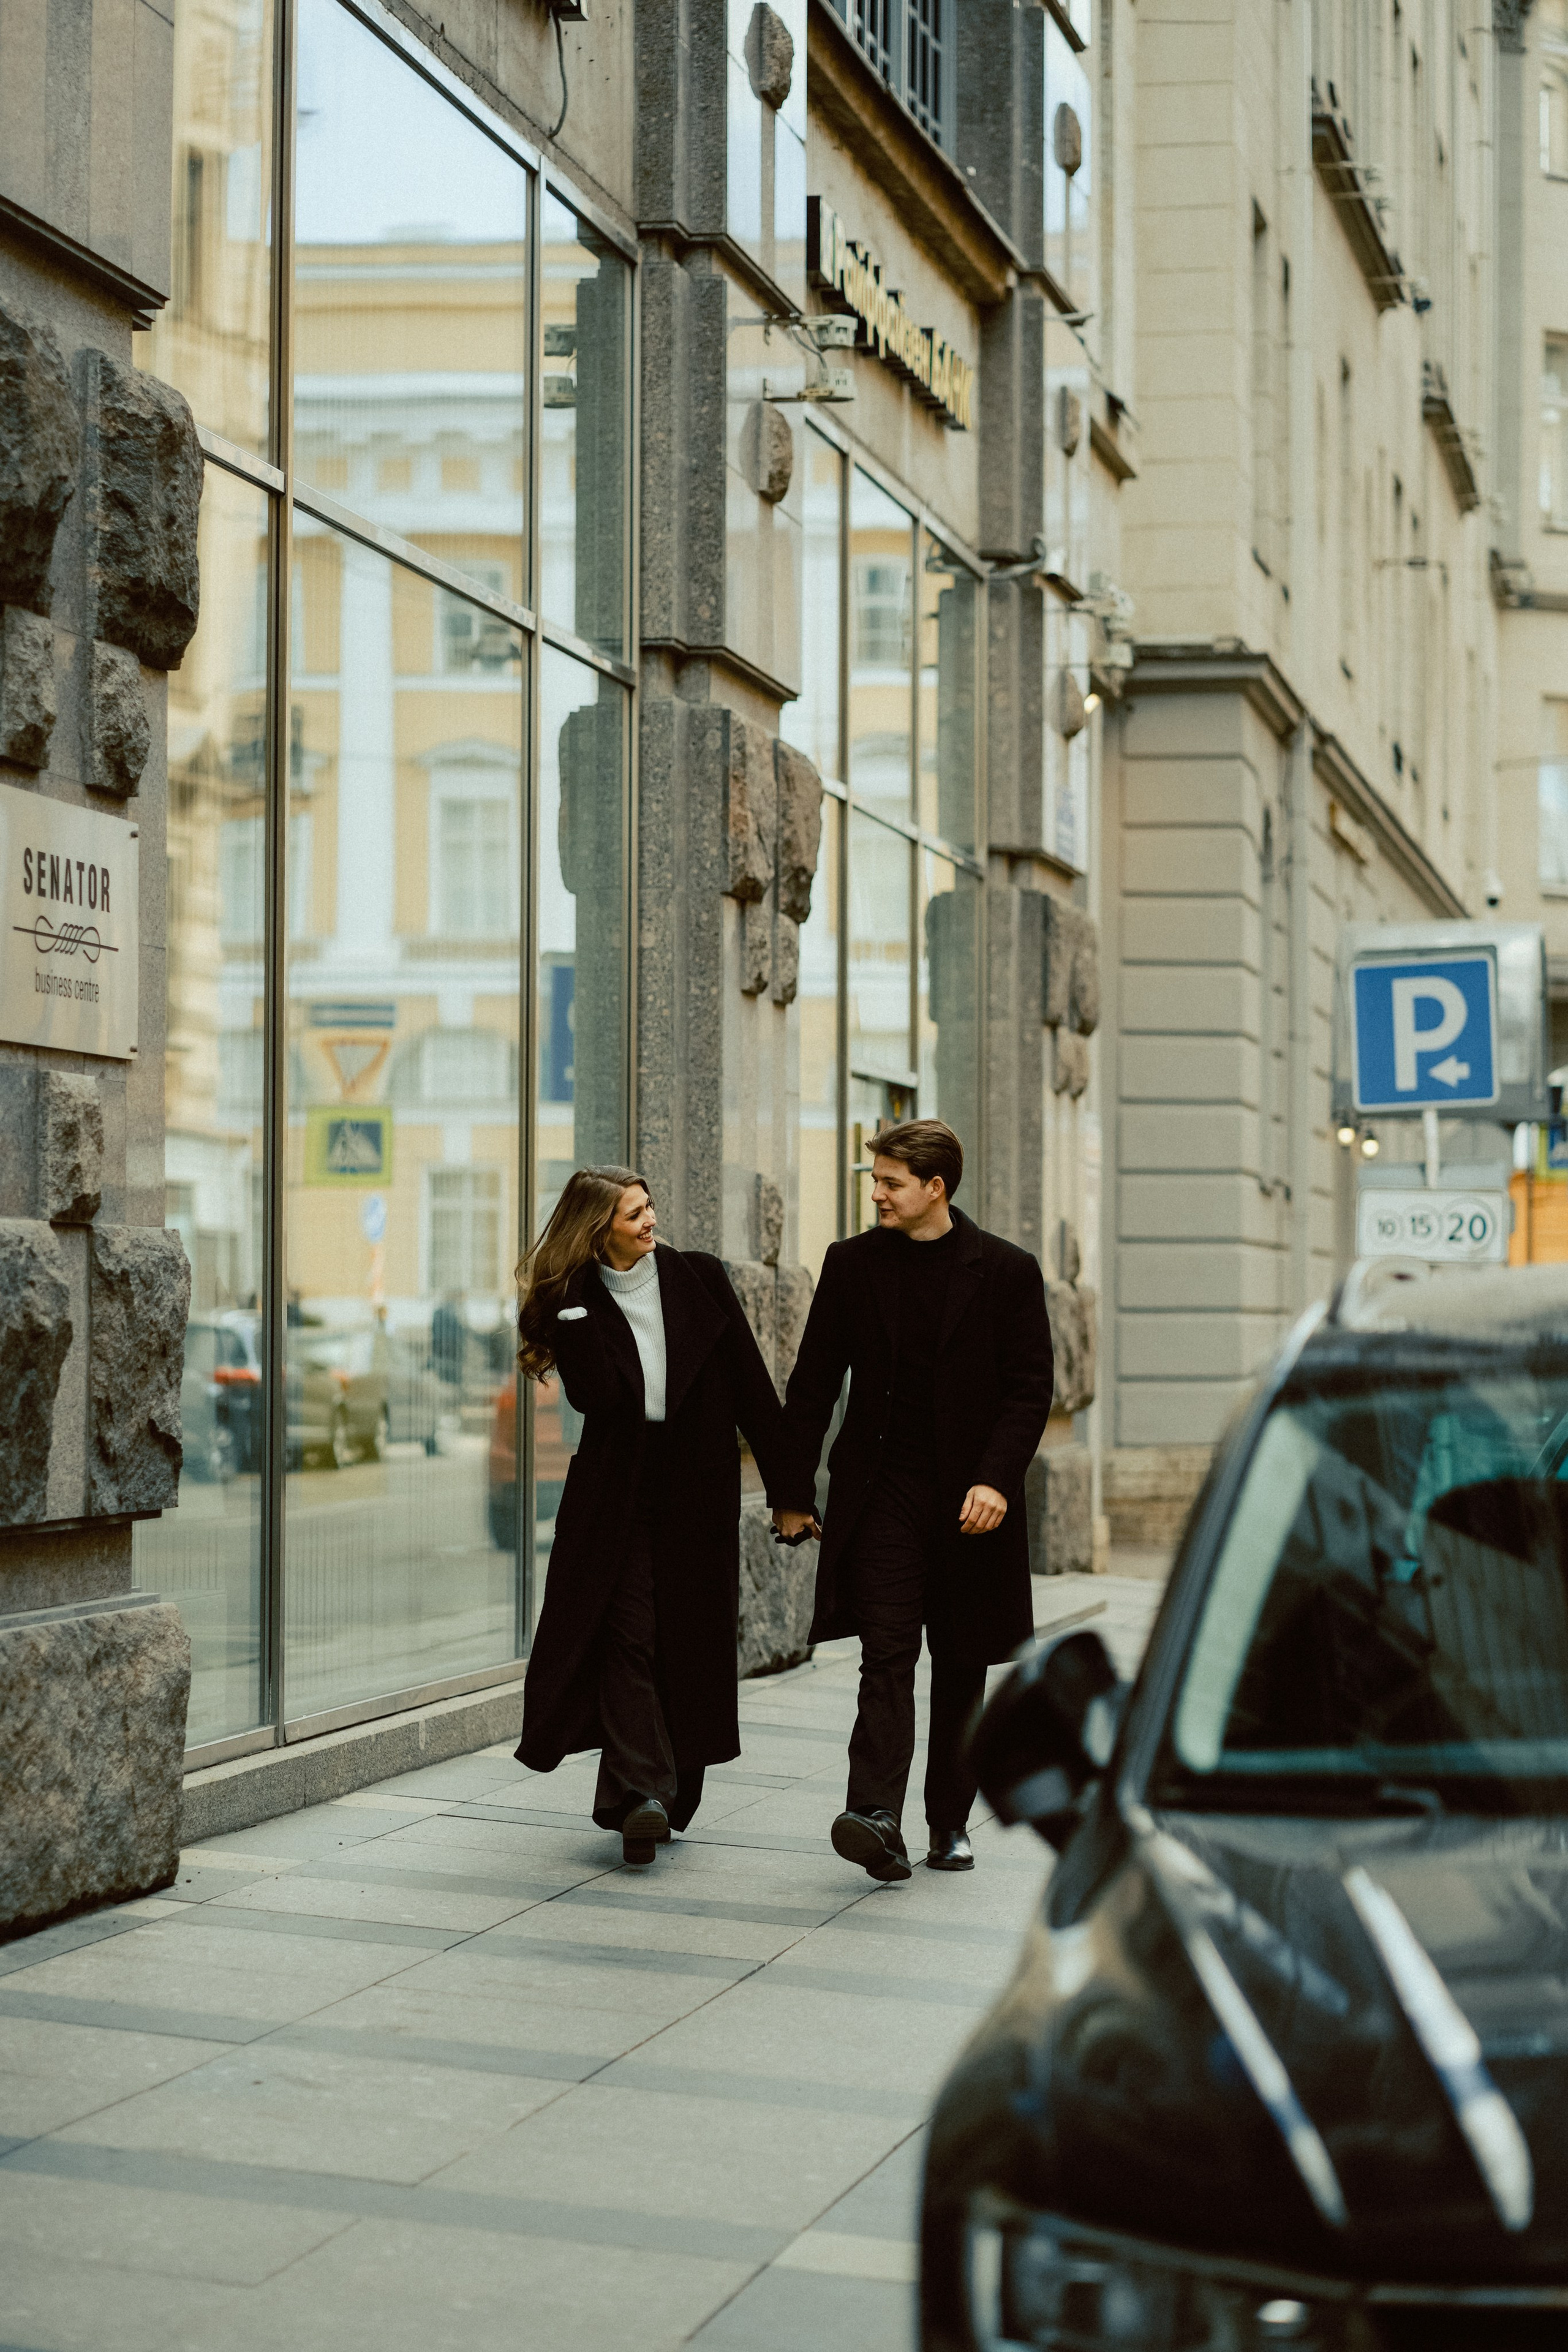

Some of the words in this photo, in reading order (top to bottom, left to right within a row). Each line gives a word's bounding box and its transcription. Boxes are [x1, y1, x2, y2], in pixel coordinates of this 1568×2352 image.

[23, 847, 110, 913] SENATOR
[35, 966, 72, 998] business
[75, 978, 99, 1003] centre
[1391, 976, 1468, 1092] P
[1378, 1218, 1396, 1235] 10
[1411, 1215, 1432, 1238] 15
[1448, 1213, 1487, 1242] 20
